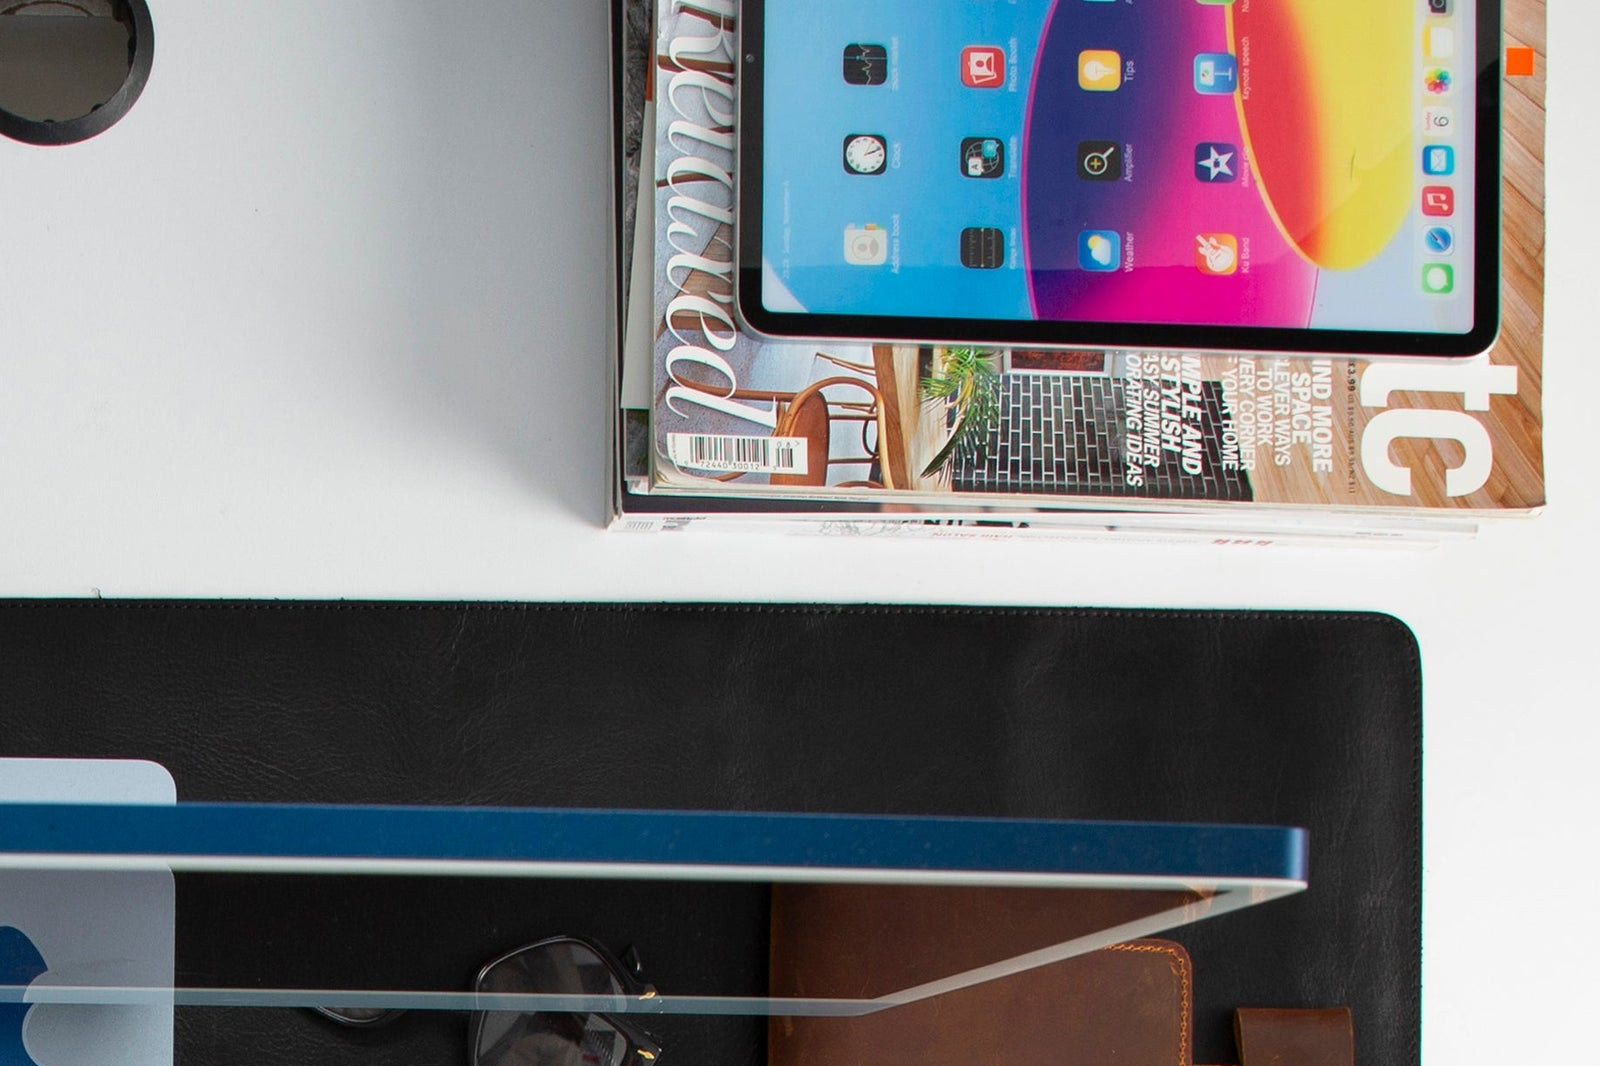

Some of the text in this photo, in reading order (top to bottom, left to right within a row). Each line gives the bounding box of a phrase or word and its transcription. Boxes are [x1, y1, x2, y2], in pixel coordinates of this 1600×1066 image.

[1124, 61, 1135, 82] Tips
[1240, 37, 1251, 100] Keynote speech
[1123, 144, 1133, 182] Amplifier
[1124, 232, 1134, 272] Weather
[1241, 238, 1250, 260] Band
[1125, 353, 1144, 487] ORATING IDEAS
[1143, 353, 1161, 468] ASY SUMMER
[1161, 355, 1182, 454] STYLISH
[1181, 355, 1203, 475] MPLE AND
[1221, 368, 1239, 415] YOUR
[1256, 368, 1273, 446] TO WORK
[1273, 360, 1292, 466] LEVER WAYS
[1291, 371, 1311, 445] SPACE
[1311, 360, 1333, 473] IND MORE
[1221, 420, 1240, 472] HOME
[1238, 400, 1256, 471] CORNER
